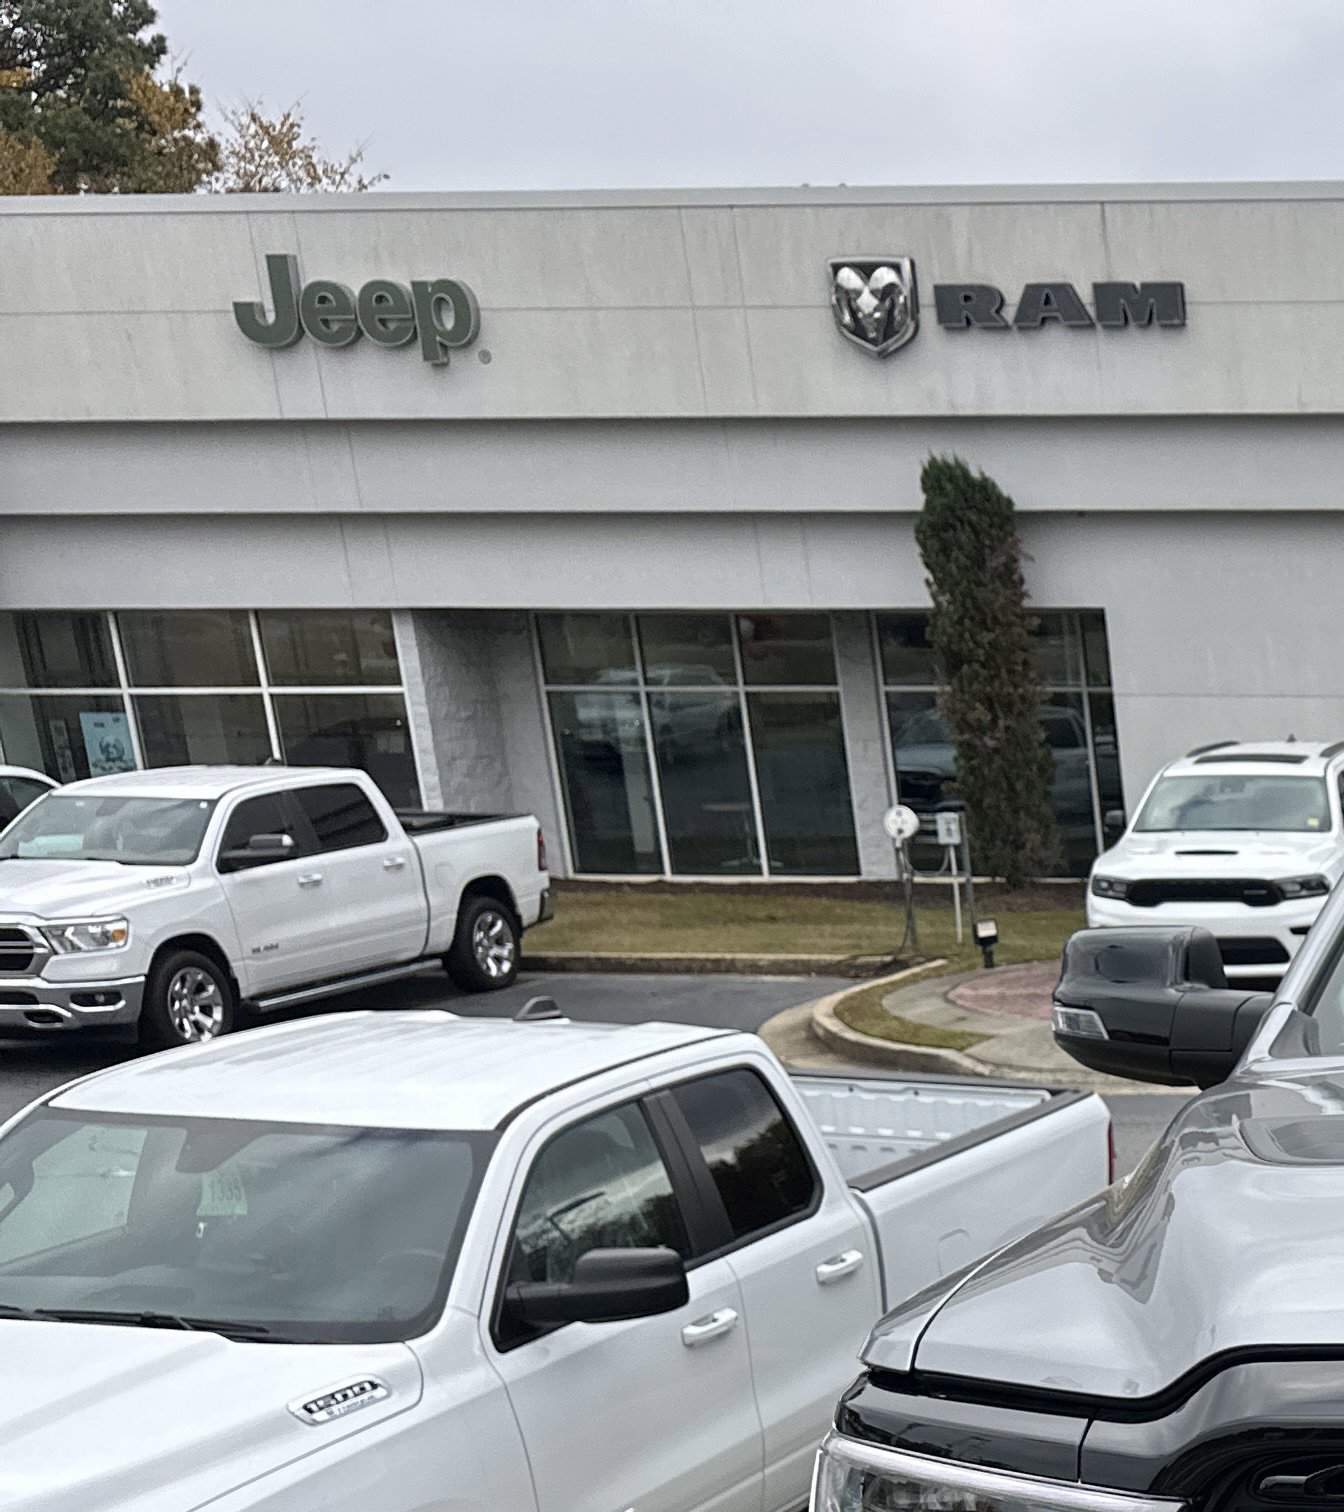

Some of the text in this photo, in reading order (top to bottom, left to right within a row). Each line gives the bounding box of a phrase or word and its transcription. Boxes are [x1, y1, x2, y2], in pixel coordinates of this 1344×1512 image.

[233, 254, 480, 366] Jeep
[934, 282, 1187, 328] RAM
[305, 1380, 375, 1413] 1500
